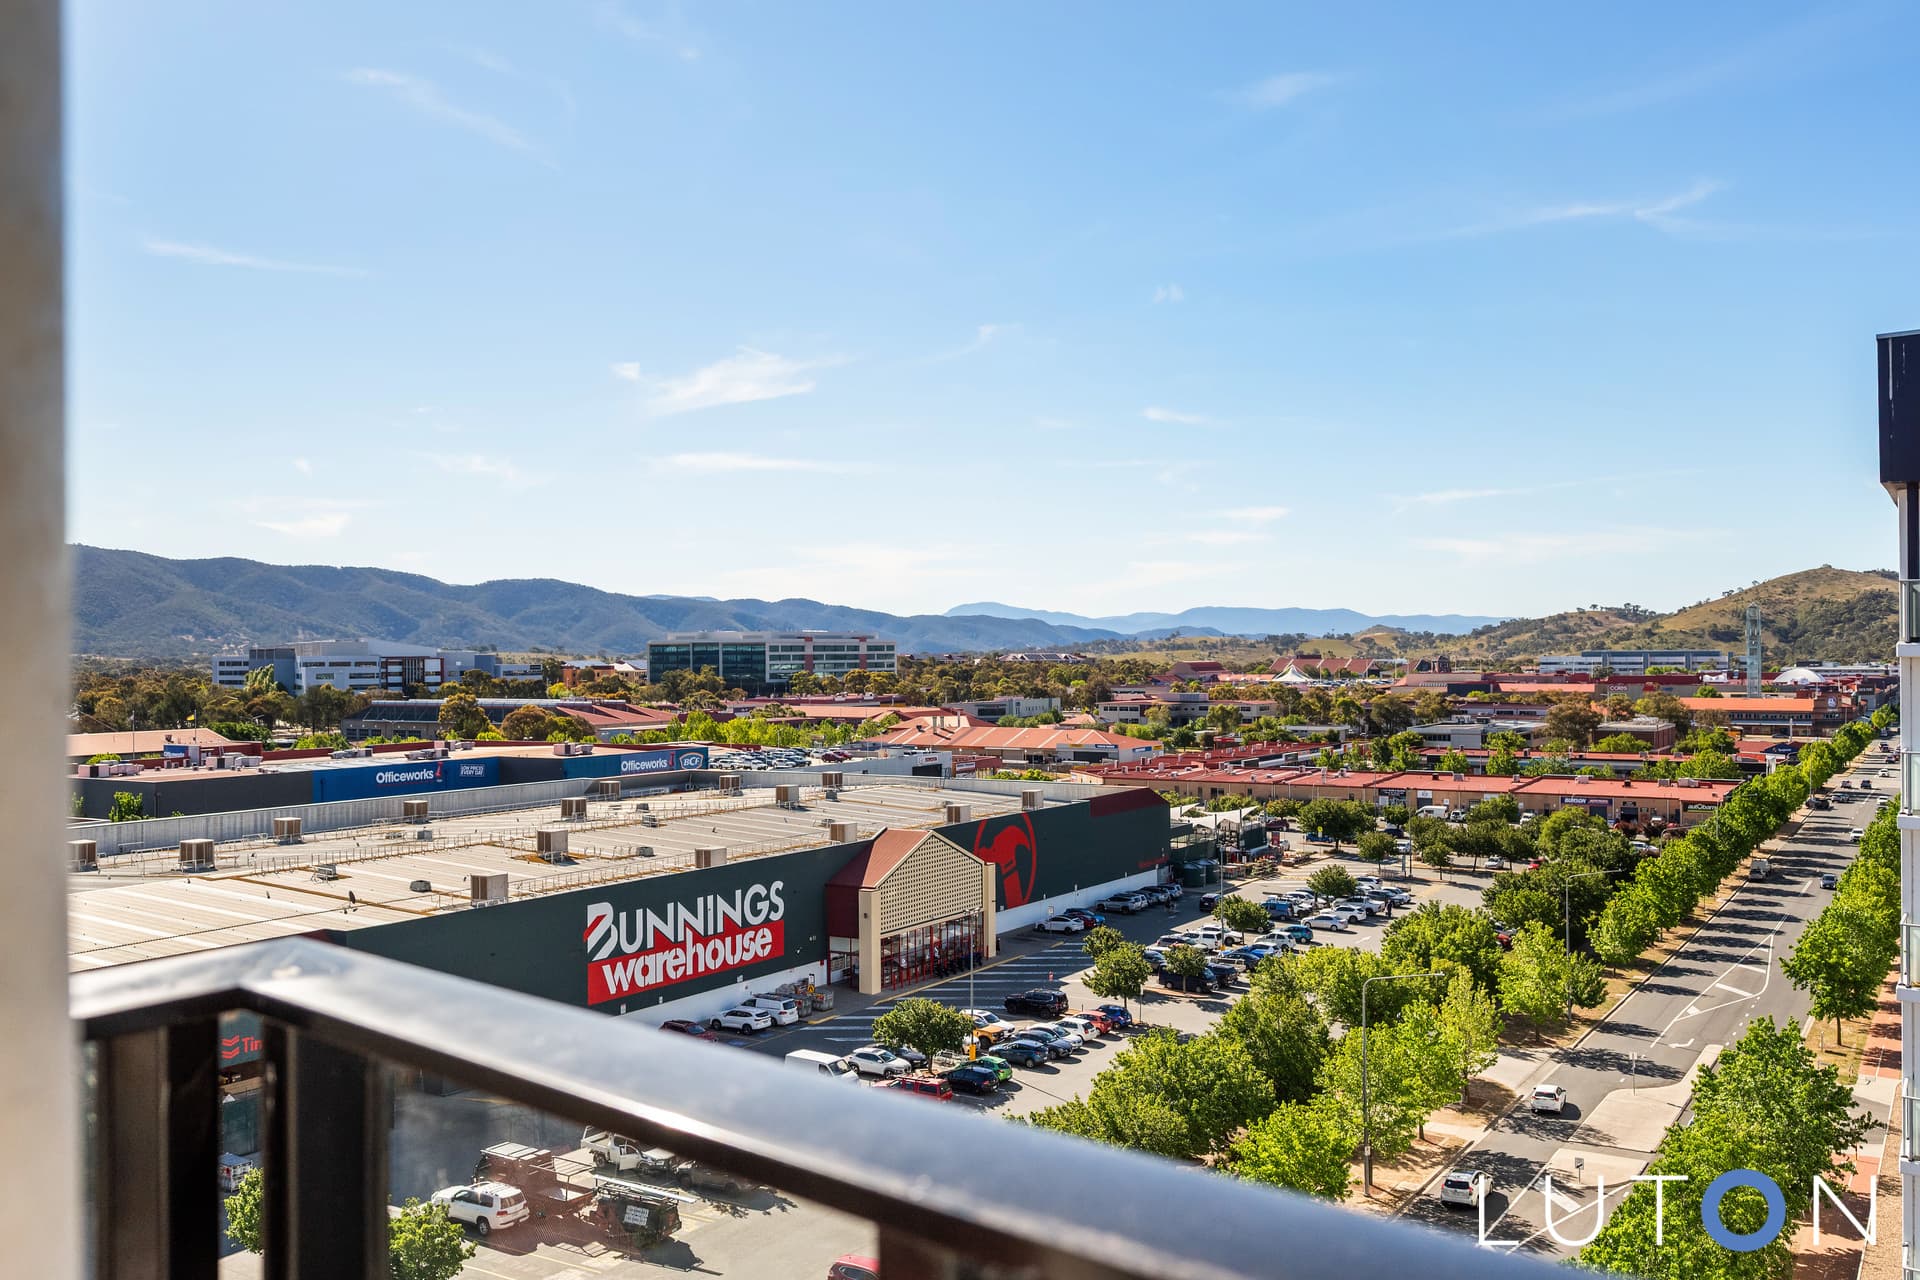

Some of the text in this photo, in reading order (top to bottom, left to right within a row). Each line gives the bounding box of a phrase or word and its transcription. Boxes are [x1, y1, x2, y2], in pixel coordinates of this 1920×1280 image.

[621, 758, 668, 772] Officeworks
[683, 756, 700, 767] BCF
[375, 768, 434, 784] Officeworks
[585, 880, 785, 961] BUNNINGS
[602, 927, 773, 995] warehouse
